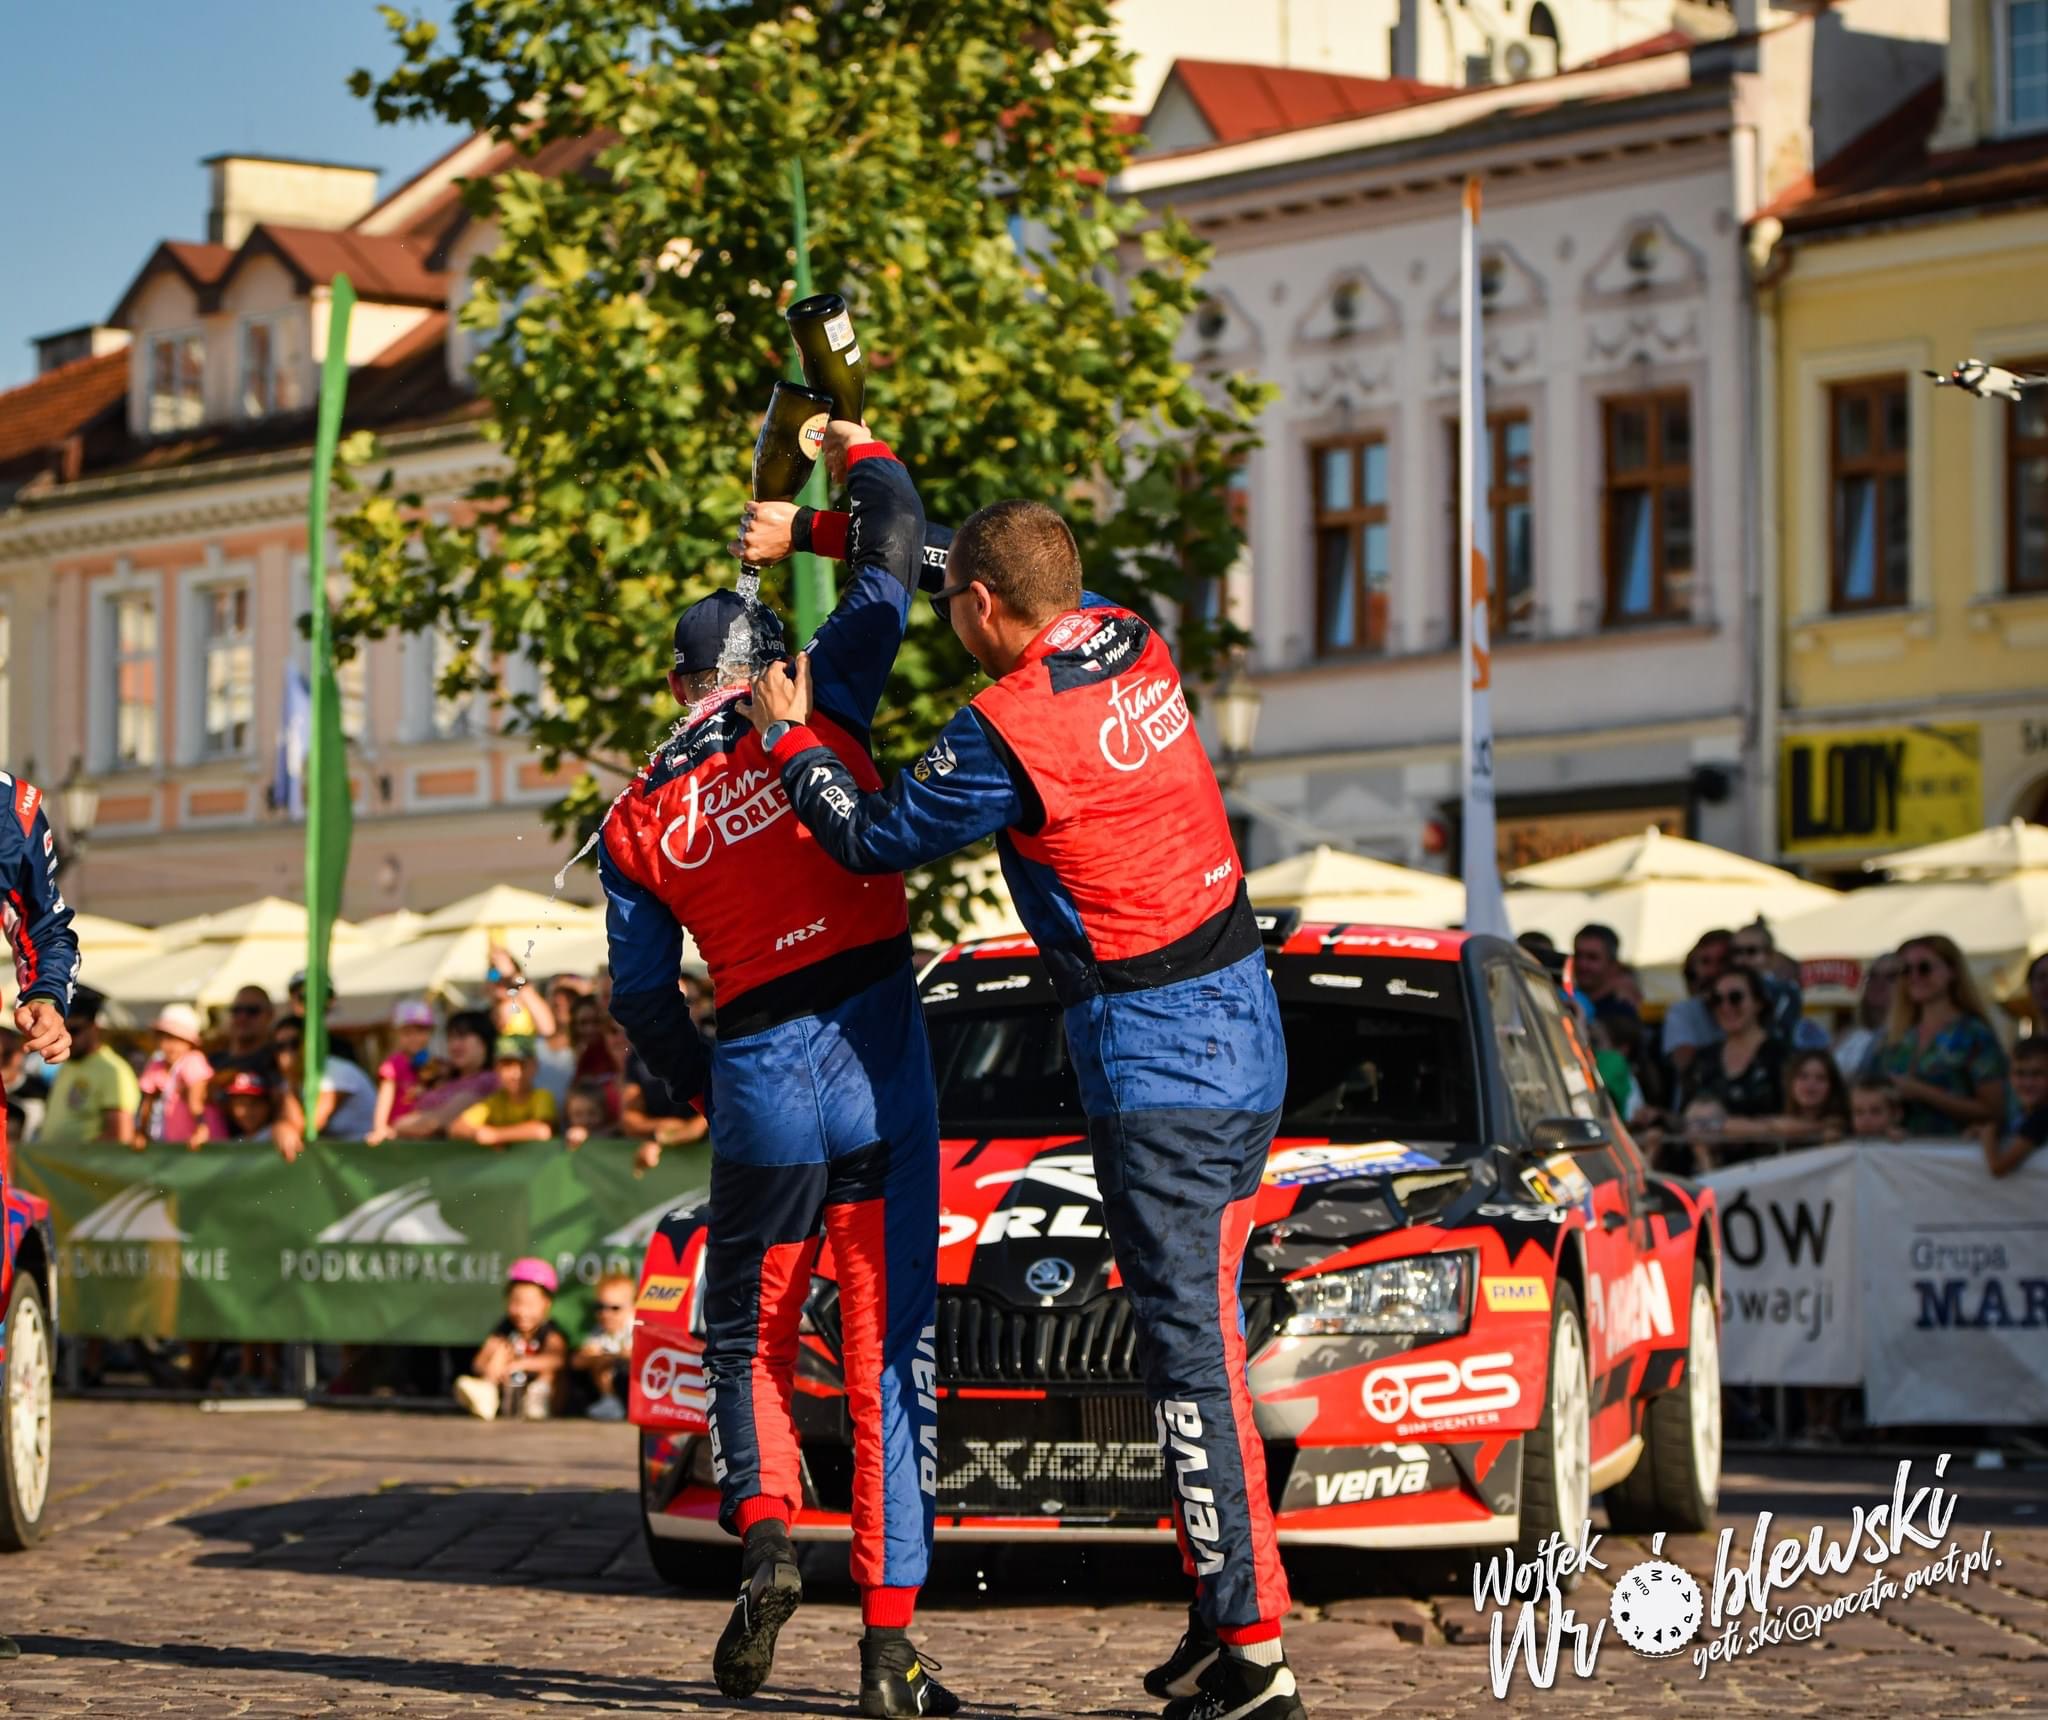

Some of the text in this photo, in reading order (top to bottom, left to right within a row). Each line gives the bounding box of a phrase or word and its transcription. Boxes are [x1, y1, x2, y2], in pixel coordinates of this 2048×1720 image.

[1081, 622, 1117, 656] HRX
[1791, 738, 1907, 839] LODY
[725, 786, 789, 837] ORLE
[1205, 857, 1232, 887] HRX
[776, 917, 827, 951] HRX
[280, 1248, 503, 1285] PODKARPACKIE
[1912, 1238, 2009, 1275] Grupa
[644, 1285, 684, 1300] RMF
[1493, 1285, 1538, 1298] RMF
[1914, 1280, 2048, 1329] MAR
[651, 1403, 706, 1424] SIM-CEN
[1397, 1411, 1500, 1436] SIM-CENTER
[1165, 1400, 1225, 1577] verva
[1315, 1461, 1430, 1506] verva
